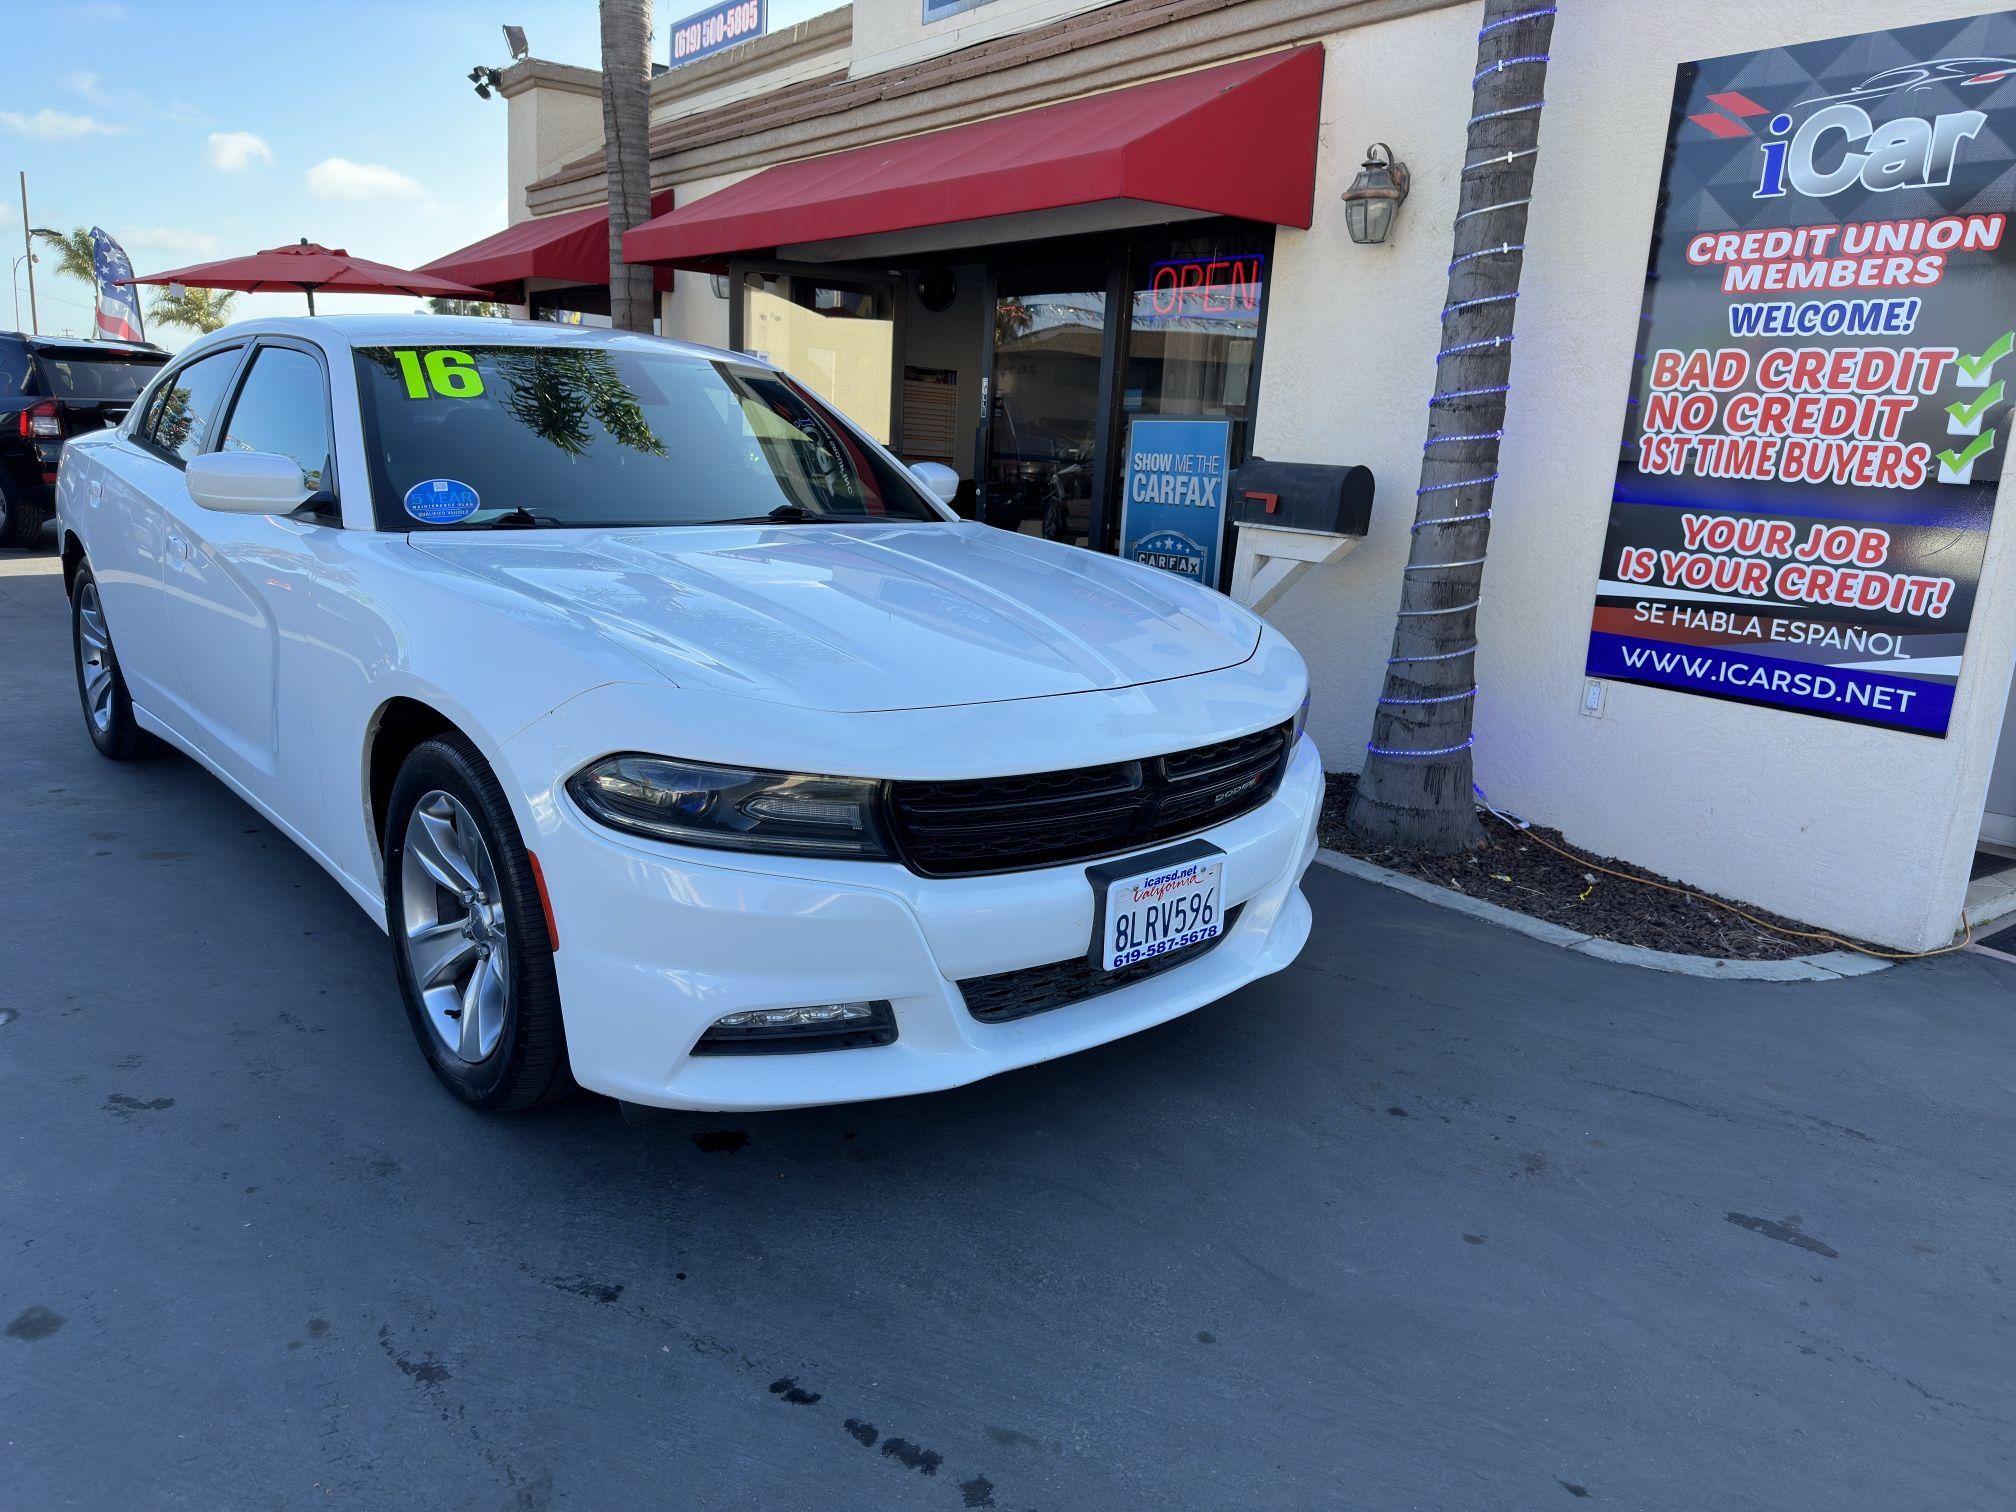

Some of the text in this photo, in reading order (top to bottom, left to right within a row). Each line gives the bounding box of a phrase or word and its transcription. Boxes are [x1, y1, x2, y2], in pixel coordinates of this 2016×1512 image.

[674, 1, 758, 59] (619) 500-5805
[1753, 104, 1988, 198] iCar
[1688, 217, 2002, 264] CREDIT UNION
[1152, 259, 1258, 314] OPEN
[1724, 256, 1944, 292] MEMBERS
[1730, 298, 1920, 335] WELCOME!
[394, 350, 485, 399] 16
[1649, 347, 1958, 394] BAD CREDIT
[1643, 393, 1917, 441] NO CREDIT
[1134, 453, 1220, 475] SHOW ME THE
[1639, 434, 1931, 489] 1ST TIME BUYERS
[426, 491, 472, 504] YEAR
[1132, 474, 1218, 508] CARFAX
[1138, 553, 1199, 574] CARFAX
[1681, 514, 1890, 567] YOUR JOB
[1618, 547, 1955, 619] IS YOUR CREDIT!
[1634, 601, 1911, 658] SE HABLA ESPAÑOL
[1621, 645, 1916, 713] WWW.ICARSD.NET
[1215, 777, 1256, 802] DODGE
[1133, 875, 1204, 902] California
[1144, 865, 1197, 888] icarsd.net
[1115, 887, 1214, 952] 8LRV596
[1114, 925, 1217, 968] 619-587-5678
